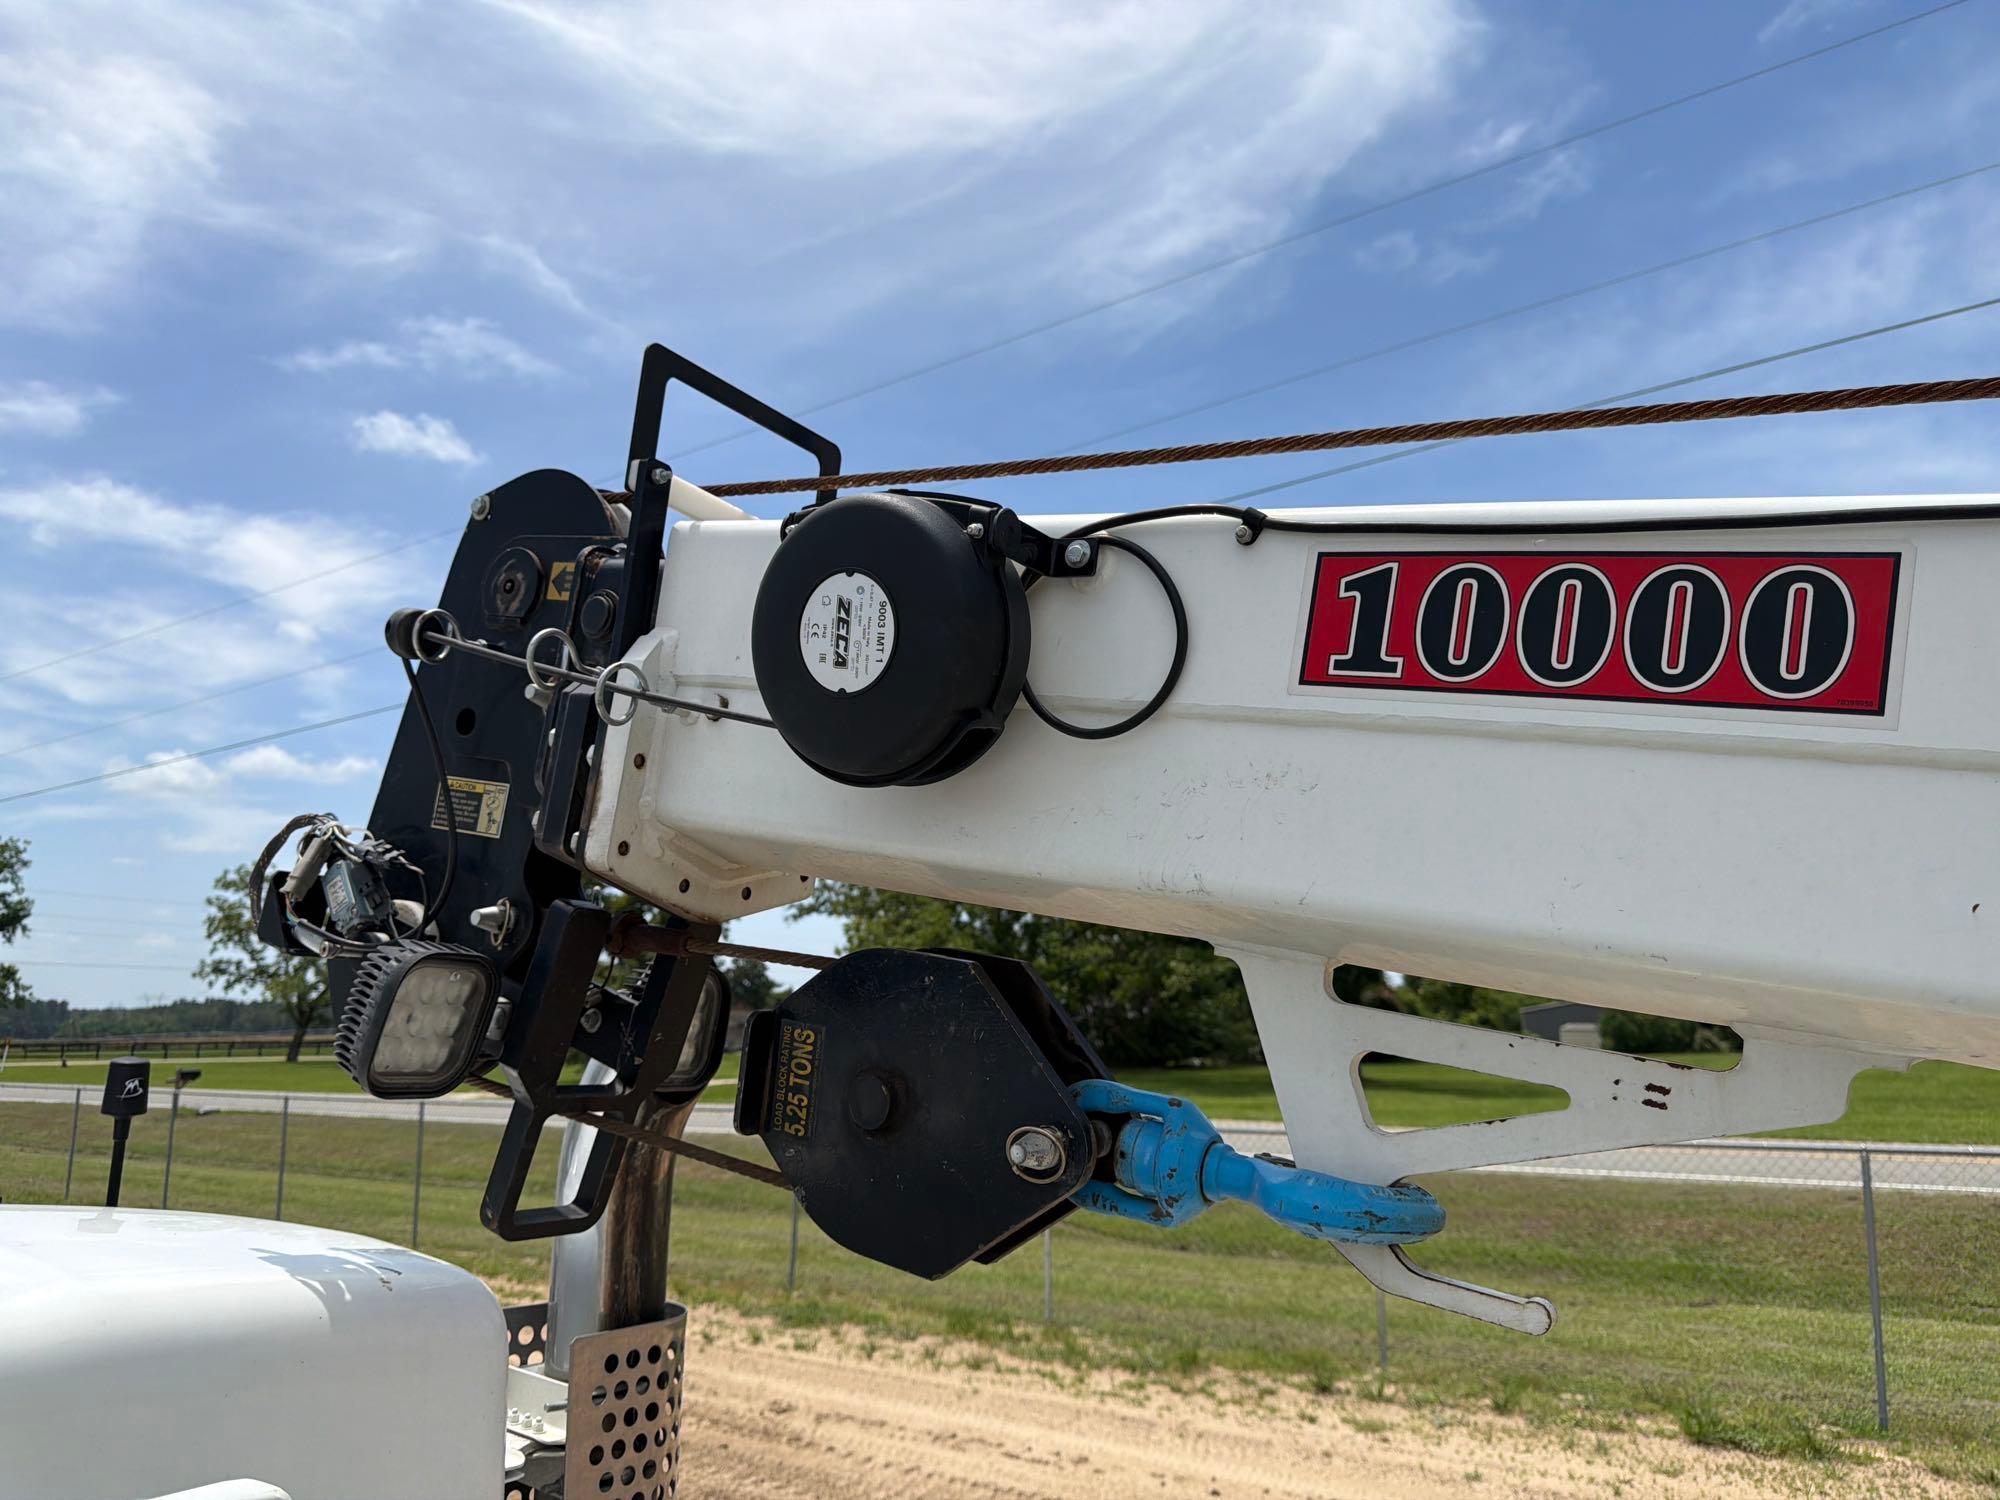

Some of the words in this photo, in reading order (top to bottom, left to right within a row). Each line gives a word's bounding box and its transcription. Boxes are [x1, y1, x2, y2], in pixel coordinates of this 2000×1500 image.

[833, 594, 852, 669] ZECA
[877, 600, 887, 631] 9003
[1327, 561, 1856, 700] 10000
[875, 632, 885, 654] IMT
[780, 1025, 792, 1065] RATING
[789, 1028, 816, 1087] TONS
[776, 1066, 788, 1100] BLOCK
[774, 1103, 784, 1131] LOAD
[784, 1091, 809, 1137] 5.25
